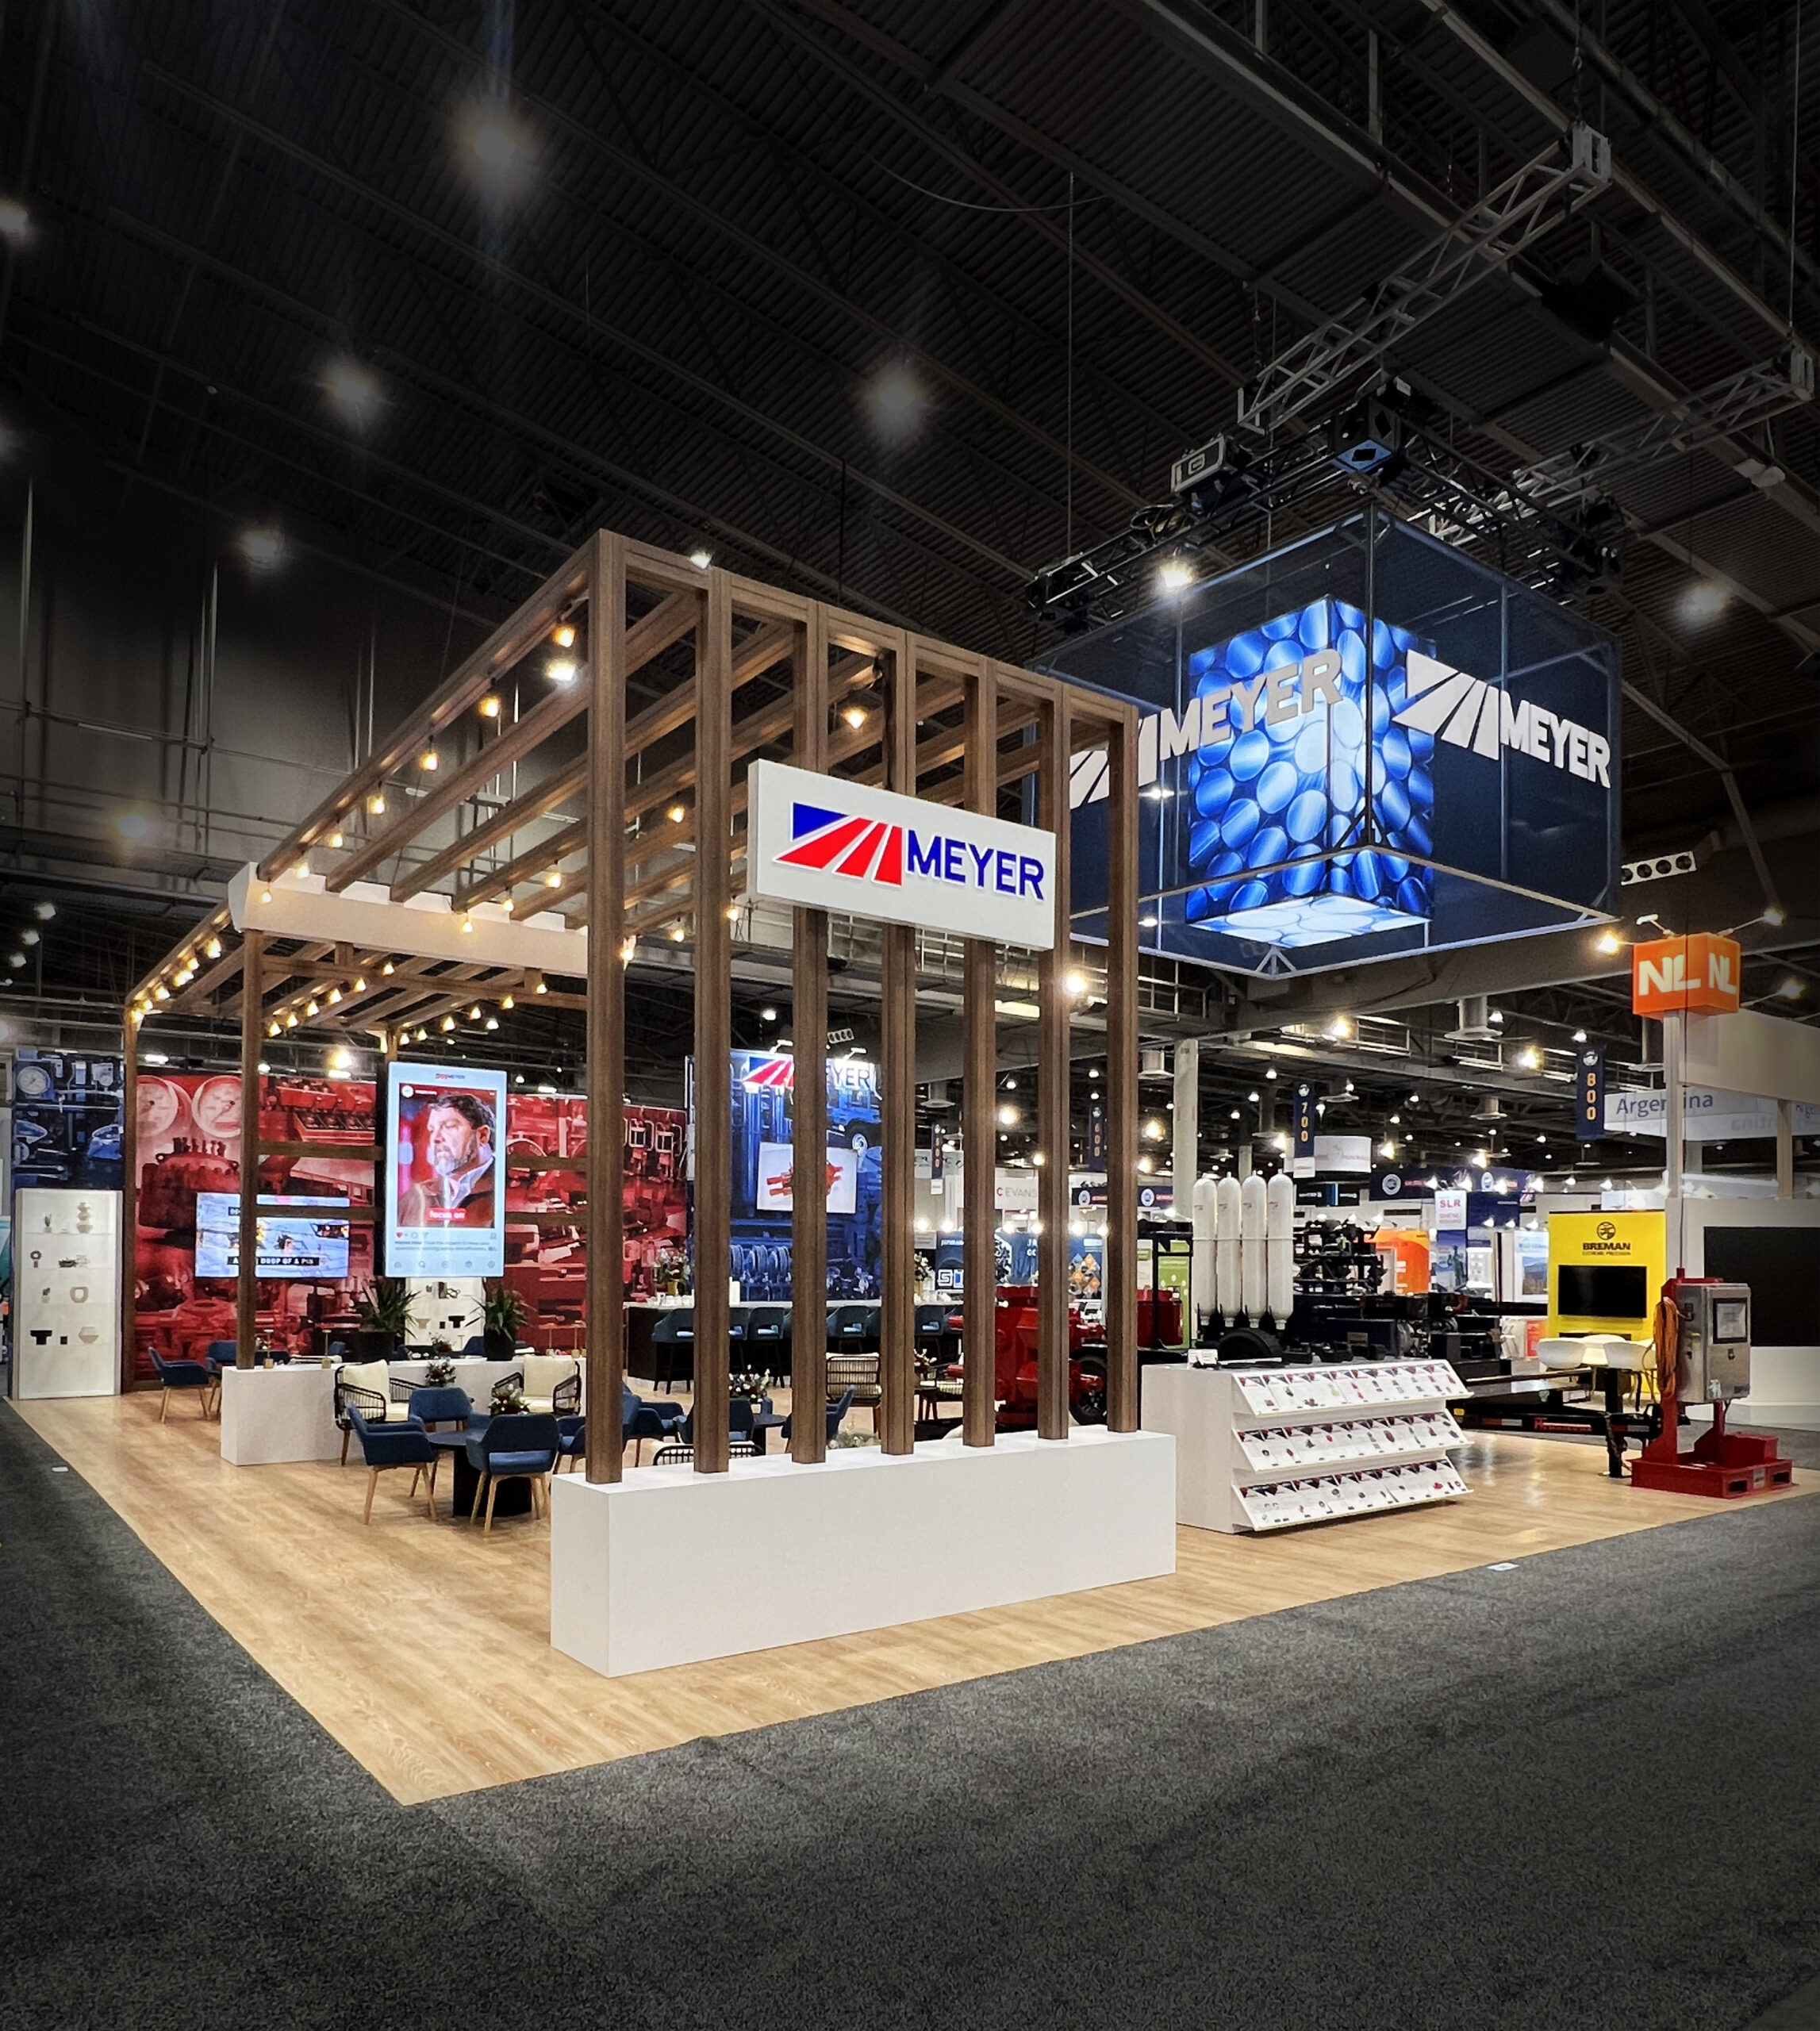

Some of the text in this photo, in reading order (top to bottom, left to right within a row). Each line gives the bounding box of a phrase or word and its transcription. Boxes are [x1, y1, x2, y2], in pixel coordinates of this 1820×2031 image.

[1159, 648, 1343, 762] MEYER
[1499, 690, 1611, 788] MEYER
[906, 829, 1045, 901] MEYER
[1638, 954, 1702, 996] NL
[1708, 952, 1737, 995] NL
[826, 1065, 870, 1089] YER
[1586, 1072, 1596, 1121] 800
[1615, 1092, 1714, 1118] Argenina
[1440, 1200, 1461, 1208] SLR
